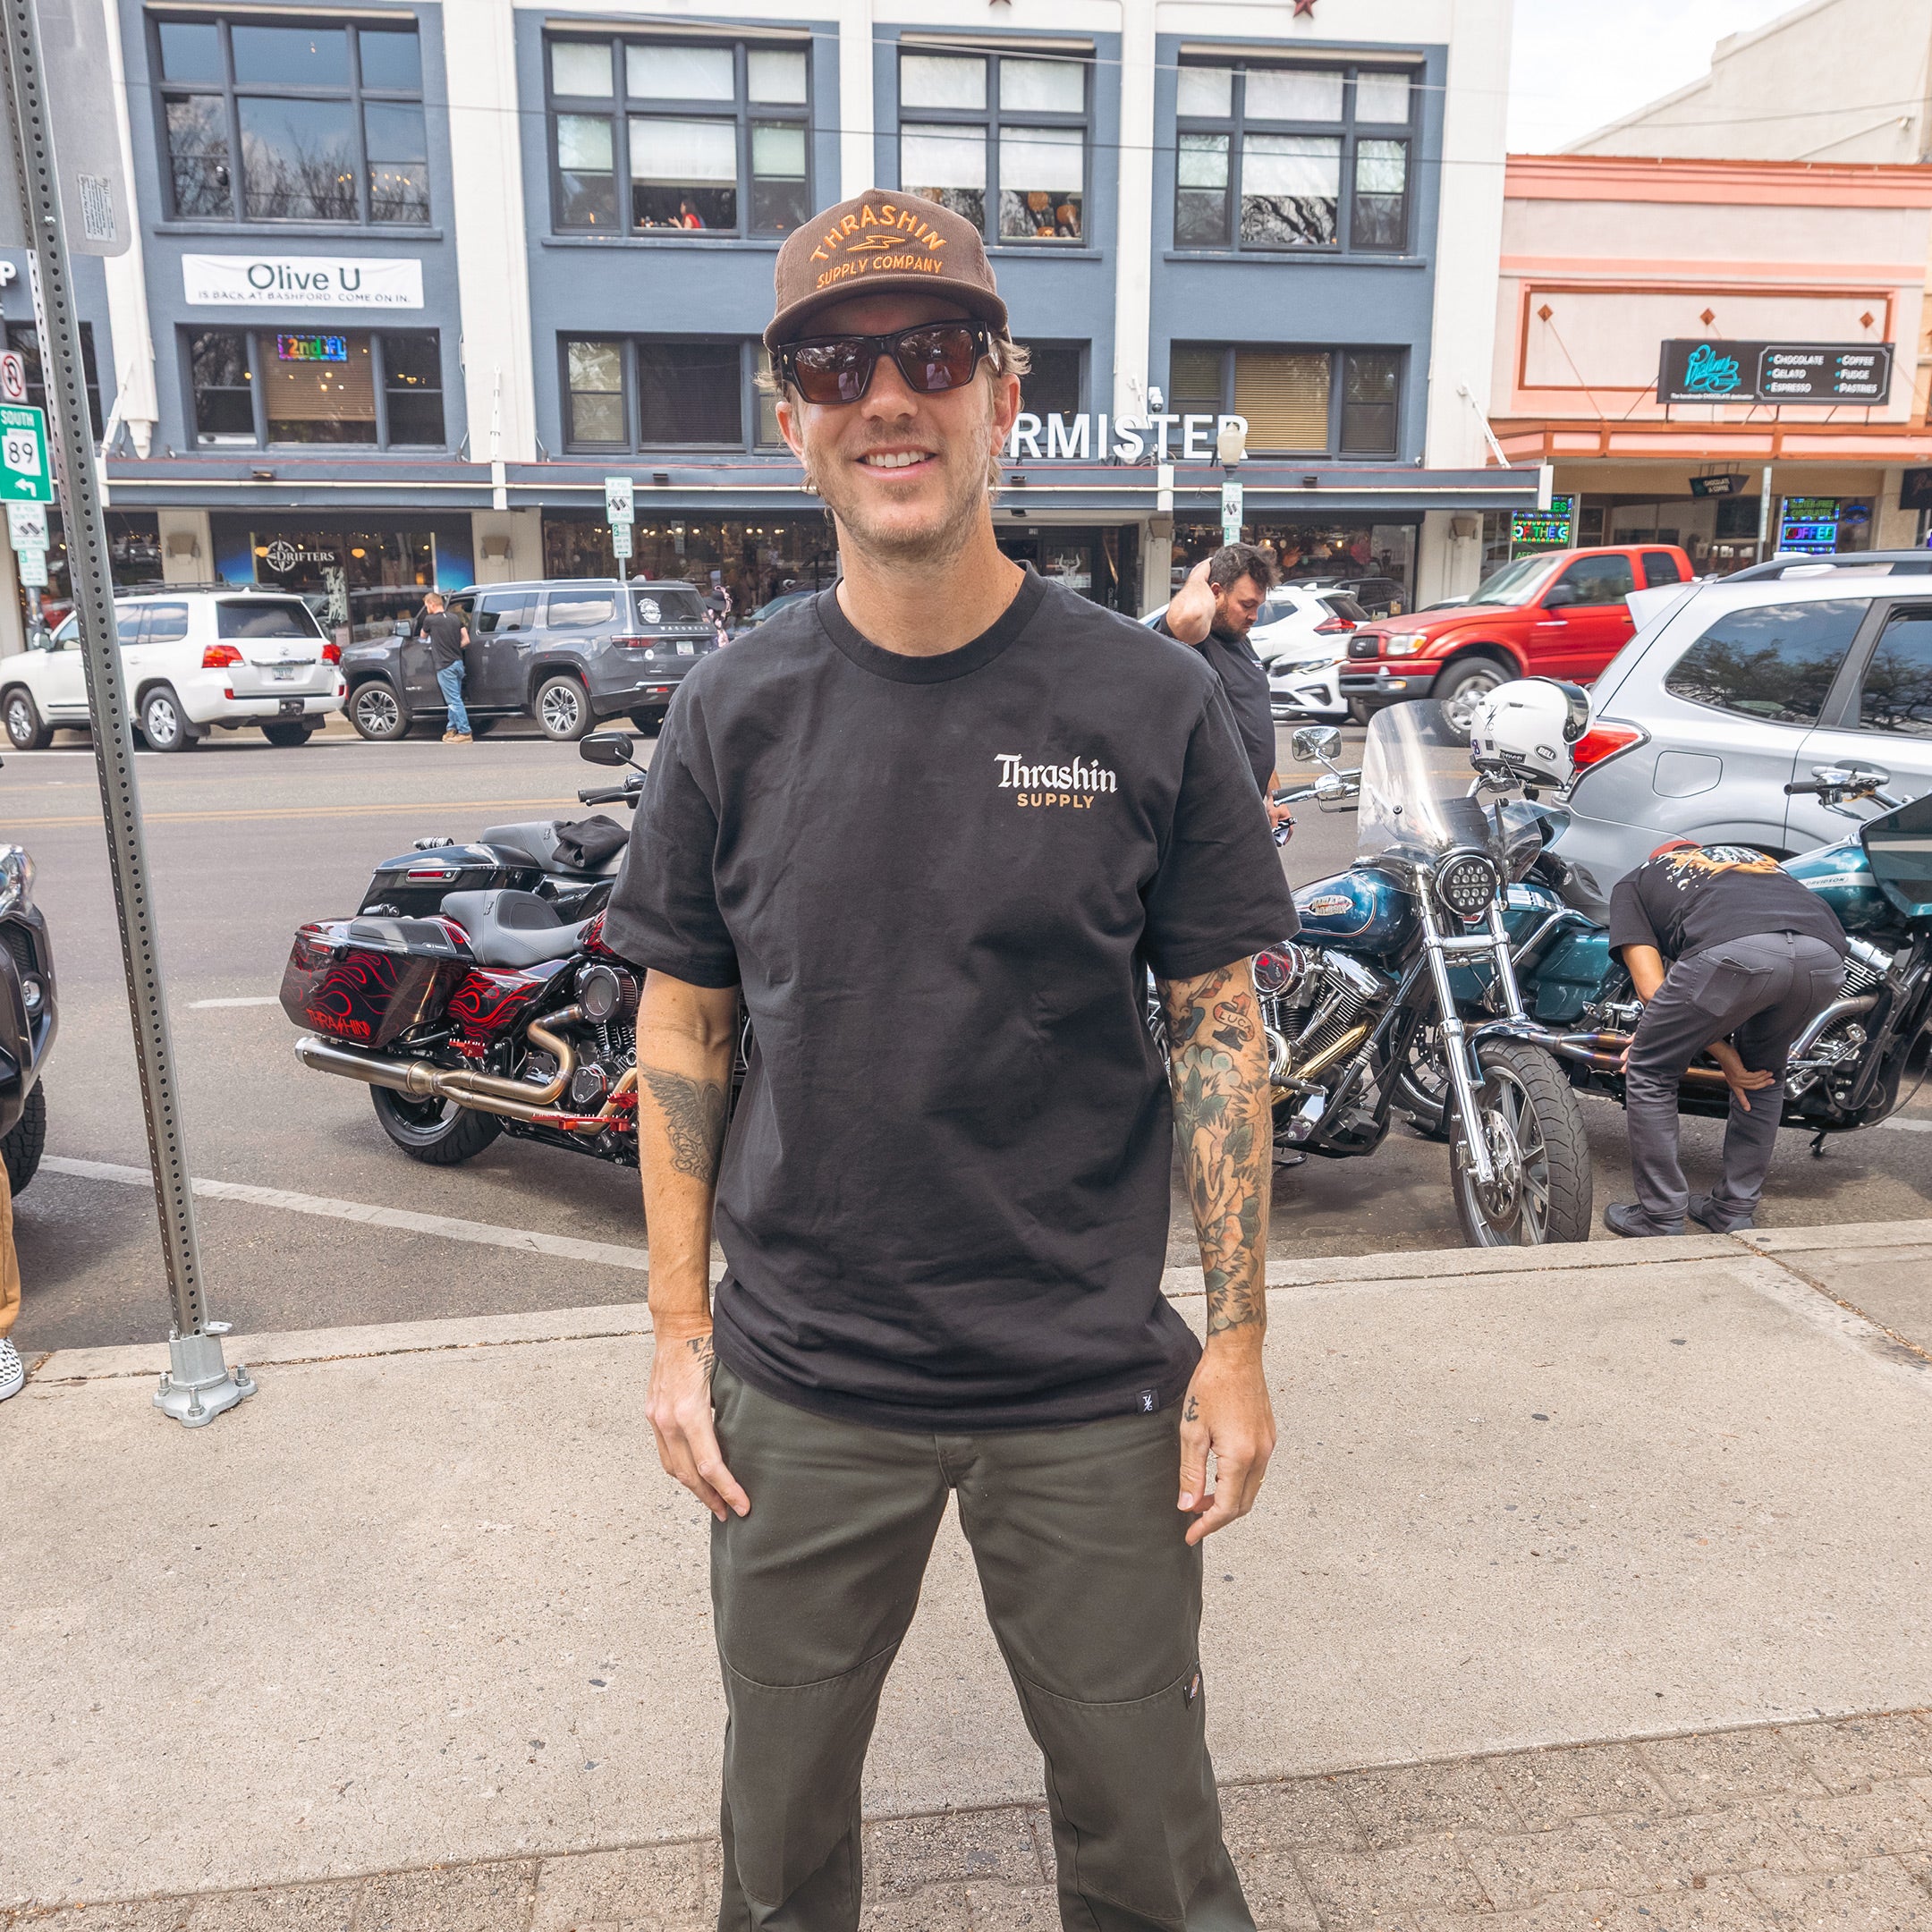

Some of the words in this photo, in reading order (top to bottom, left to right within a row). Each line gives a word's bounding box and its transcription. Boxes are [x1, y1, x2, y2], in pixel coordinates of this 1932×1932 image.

[809, 204, 947, 261] THRASHIN
[0, 260, 16, 286] P
[247, 264, 329, 291] Olive
[339, 267, 360, 292] U
[816, 258, 869, 289] SUPPLY
[873, 254, 944, 274] COMPANY
[199, 291, 208, 300] IS
[213, 292, 244, 301] BACK
[250, 292, 263, 301] AT
[338, 292, 370, 301] COME
[374, 293, 392, 302] ON
[288, 337, 322, 355] 2nd
[1773, 353, 1825, 366] CHOCOLATE
[1842, 354, 1876, 367] COFFEE
[1771, 368, 1807, 379] GELATO
[1840, 368, 1870, 380] FUDGE
[1770, 382, 1812, 394] ESPRESSO
[1838, 382, 1878, 394] PASTRIES
[1, 409, 35, 427] SOUTH
[1009, 412, 1250, 460] RMISTER
[9, 442, 33, 463] 89
[1532, 526, 1557, 539] THE
[276, 551, 335, 563] DRIFTERS
[1537, 746, 1555, 760] BELL
[994, 753, 1118, 793] Thrashin
[1016, 792, 1095, 809] SUPPLY
